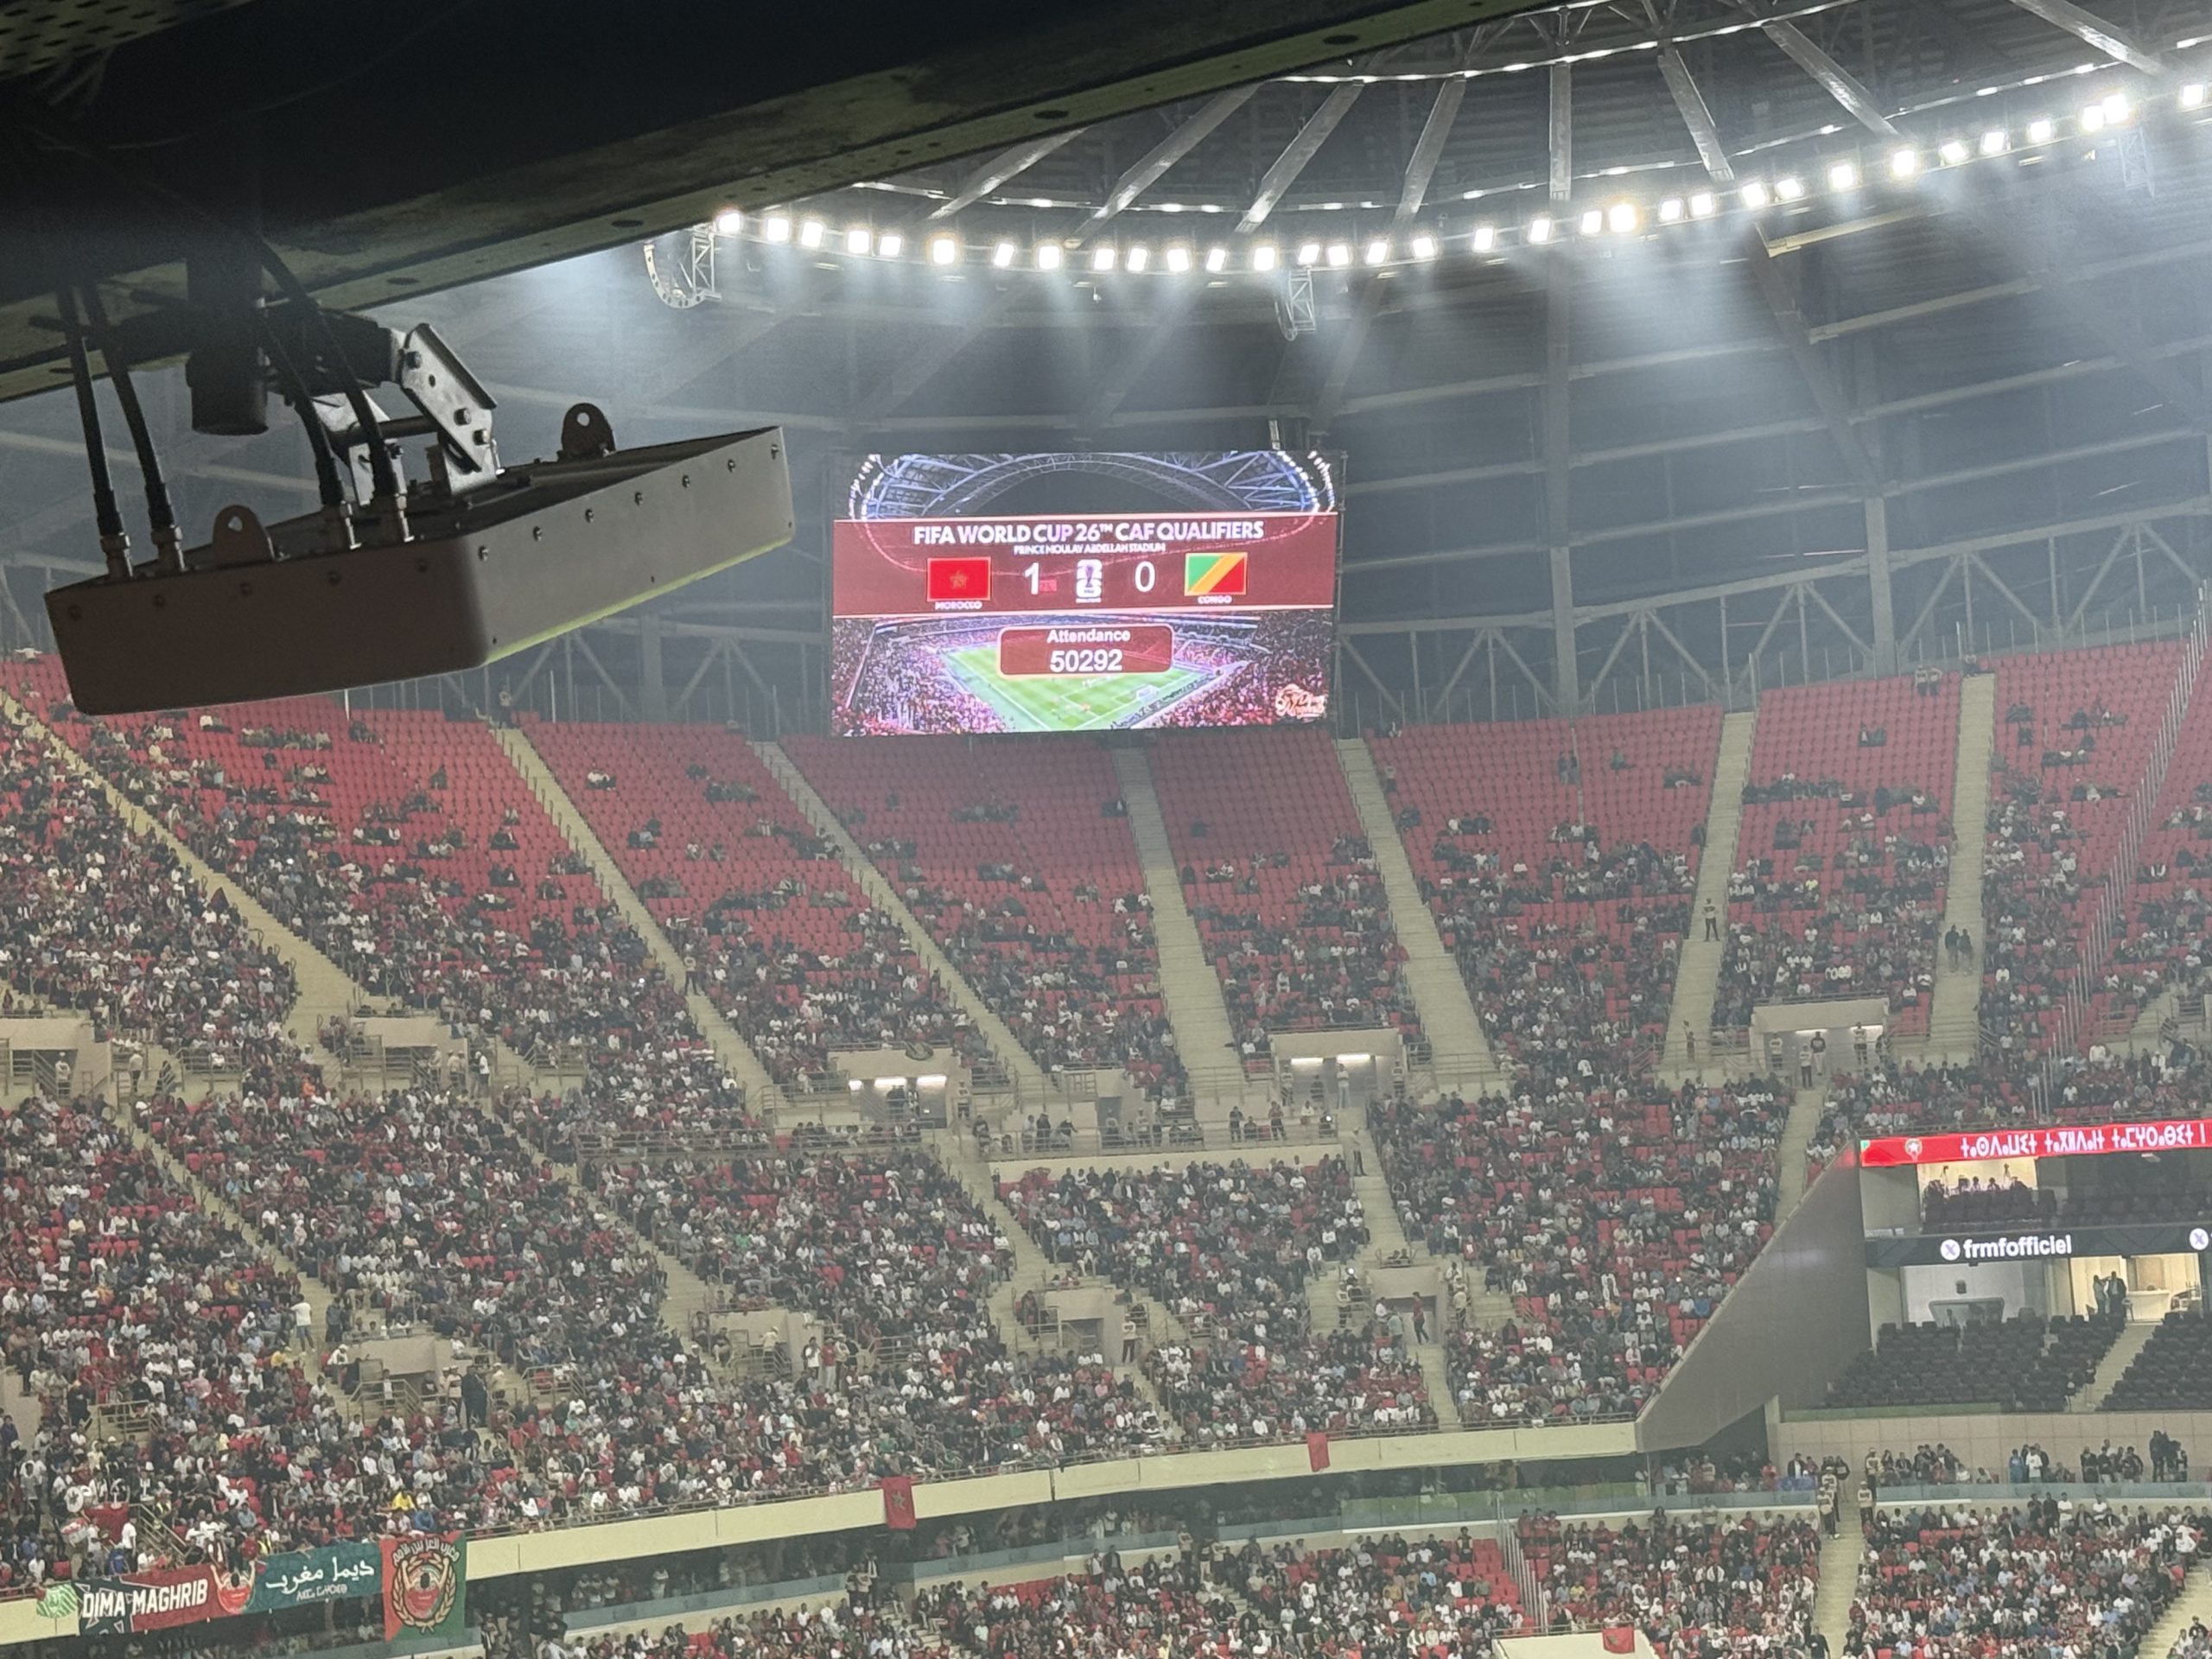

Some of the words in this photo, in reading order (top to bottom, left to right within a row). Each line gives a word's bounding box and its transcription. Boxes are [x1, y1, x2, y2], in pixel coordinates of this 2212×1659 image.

[914, 525, 956, 544] FIFA
[957, 524, 1031, 543] WORLD
[1033, 524, 1073, 543] CUP
[1116, 523, 1154, 541] CAF
[1156, 521, 1264, 540] QUALIFIERS
[1024, 563, 1039, 595] 1
[1135, 561, 1155, 593] 0
[935, 601, 982, 610] MOROCCO
[1197, 595, 1233, 604] CONGO
[1046, 629, 1131, 643] Attendance
[1050, 649, 1123, 672] 50292
[1963, 1234, 2072, 1258] frmfofficiel
[265, 1566, 324, 1594] مغرب
[332, 1556, 374, 1581] ديما
[82, 1592, 126, 1618] DIMA
[131, 1579, 209, 1616] MAGHRIB
